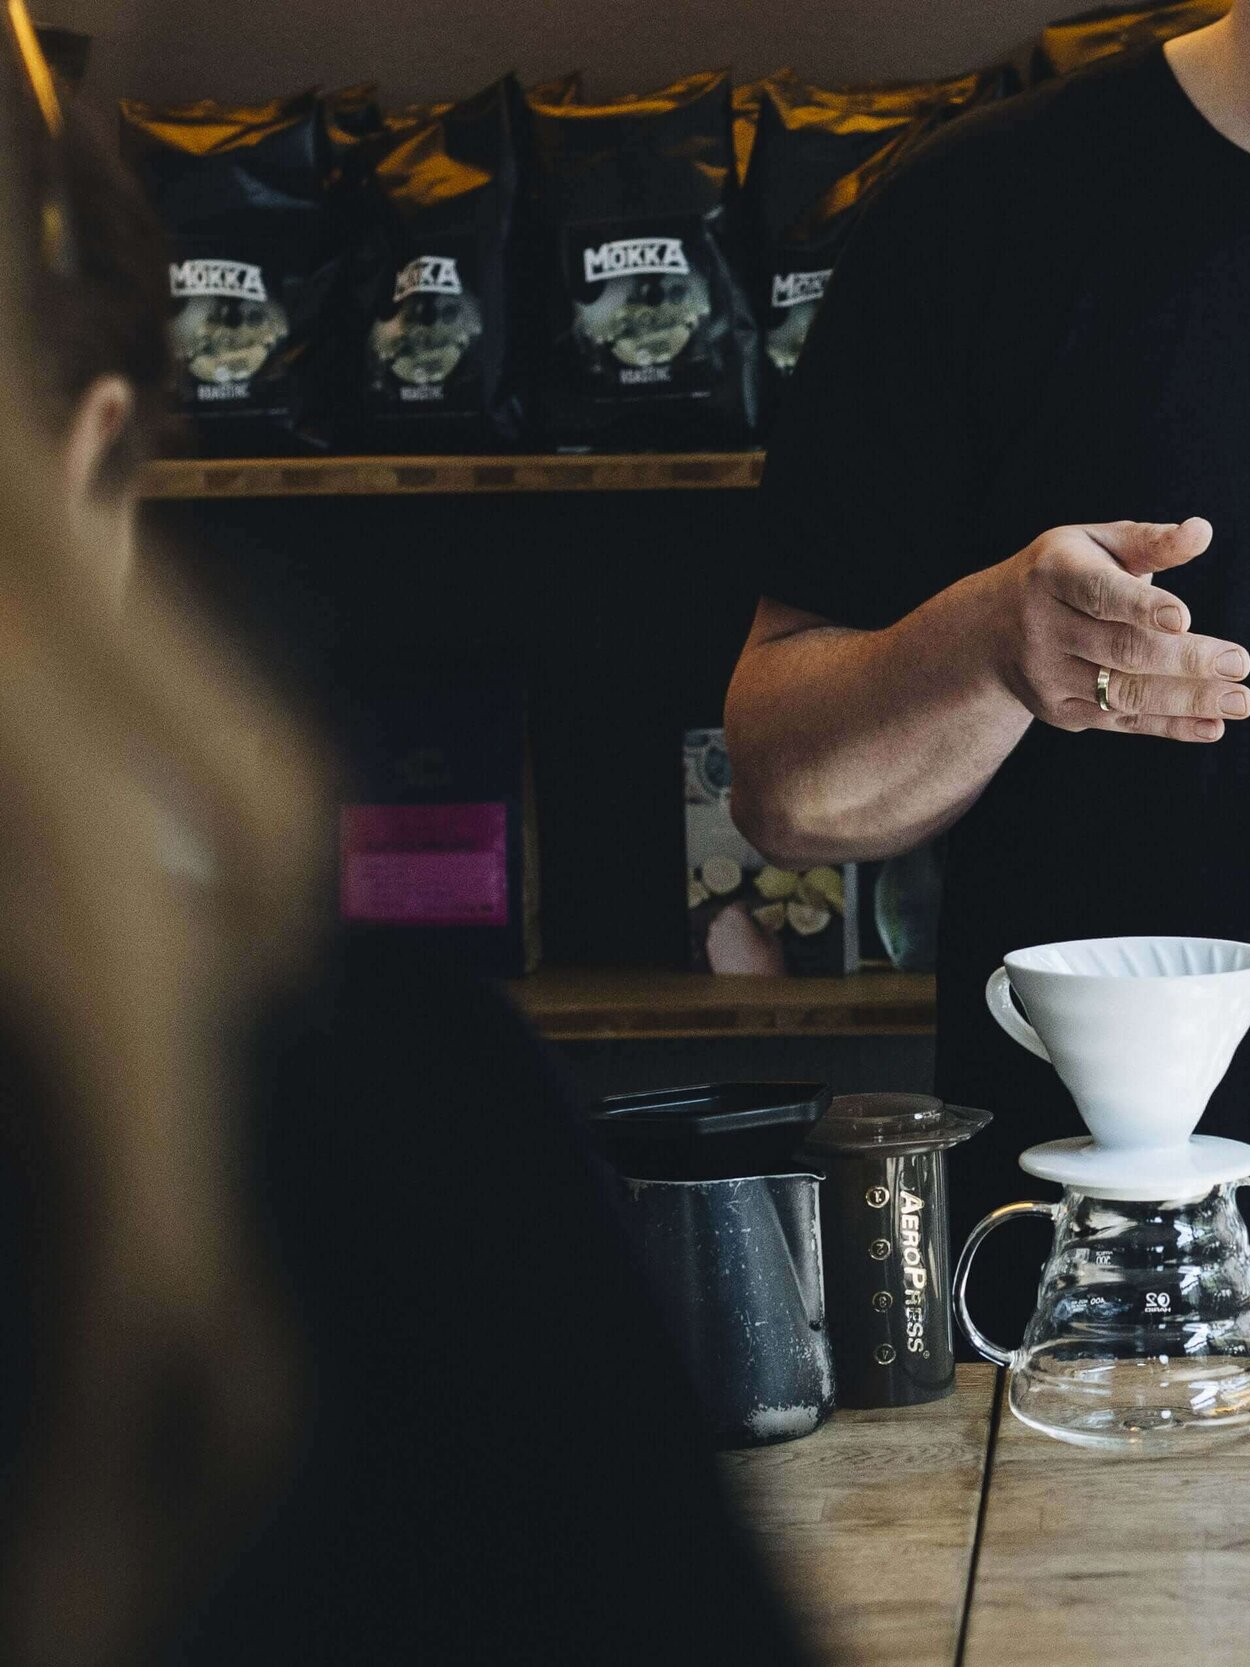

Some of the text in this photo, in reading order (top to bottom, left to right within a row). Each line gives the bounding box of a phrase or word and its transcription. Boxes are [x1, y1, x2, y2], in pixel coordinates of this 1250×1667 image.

[169, 259, 267, 301] MOKKA
[584, 238, 690, 283] MOKKA
[900, 1190, 925, 1353] AEROPRESS
